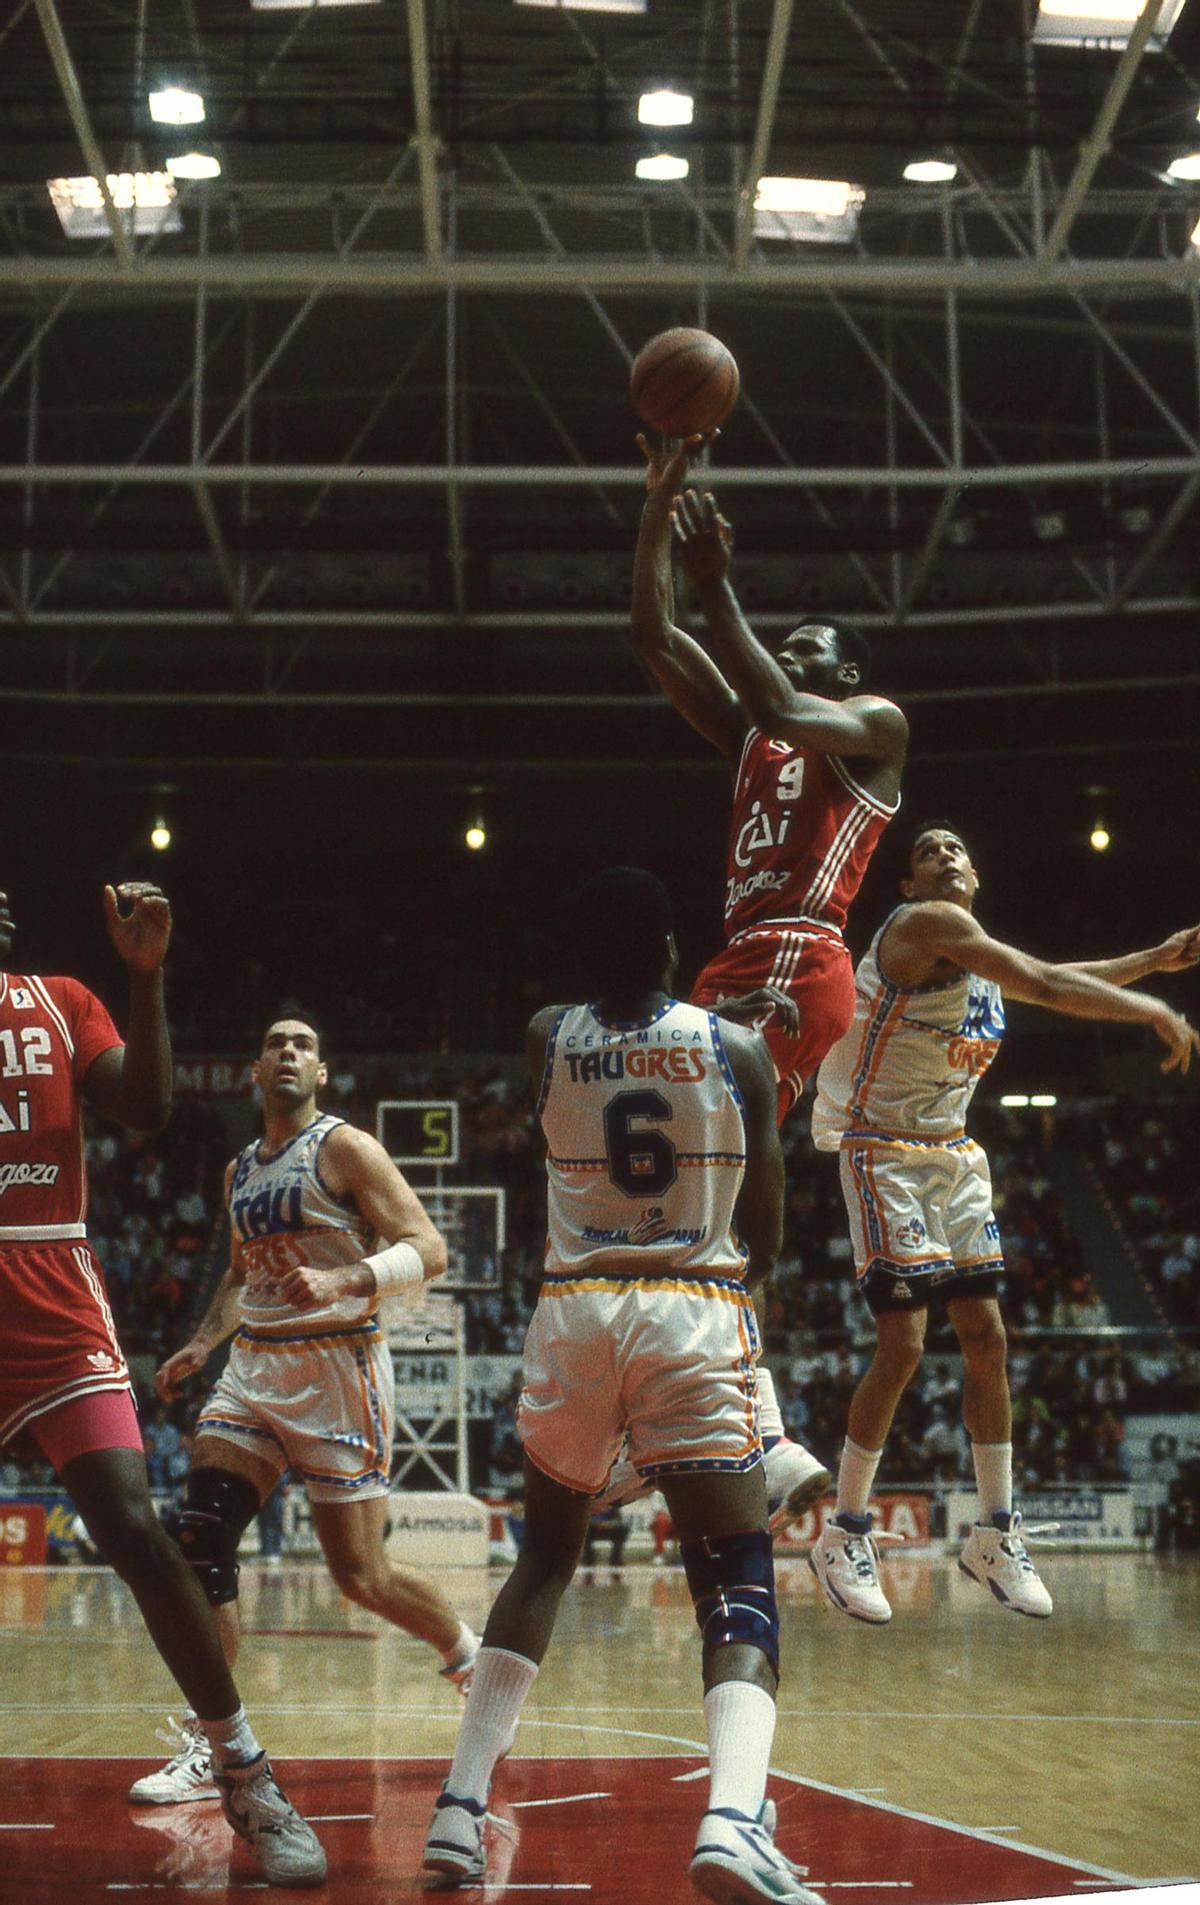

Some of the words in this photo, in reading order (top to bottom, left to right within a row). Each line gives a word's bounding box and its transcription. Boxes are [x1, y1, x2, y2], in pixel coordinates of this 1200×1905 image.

[775, 756, 805, 801] 9
[0, 1026, 54, 1078] 12
[565, 1028, 703, 1048] CERAMICA
[563, 1046, 707, 1084] TAUGRES
[422, 1110, 449, 1155] 5
[602, 1088, 678, 1199] 6
[233, 1186, 303, 1242] TAU
